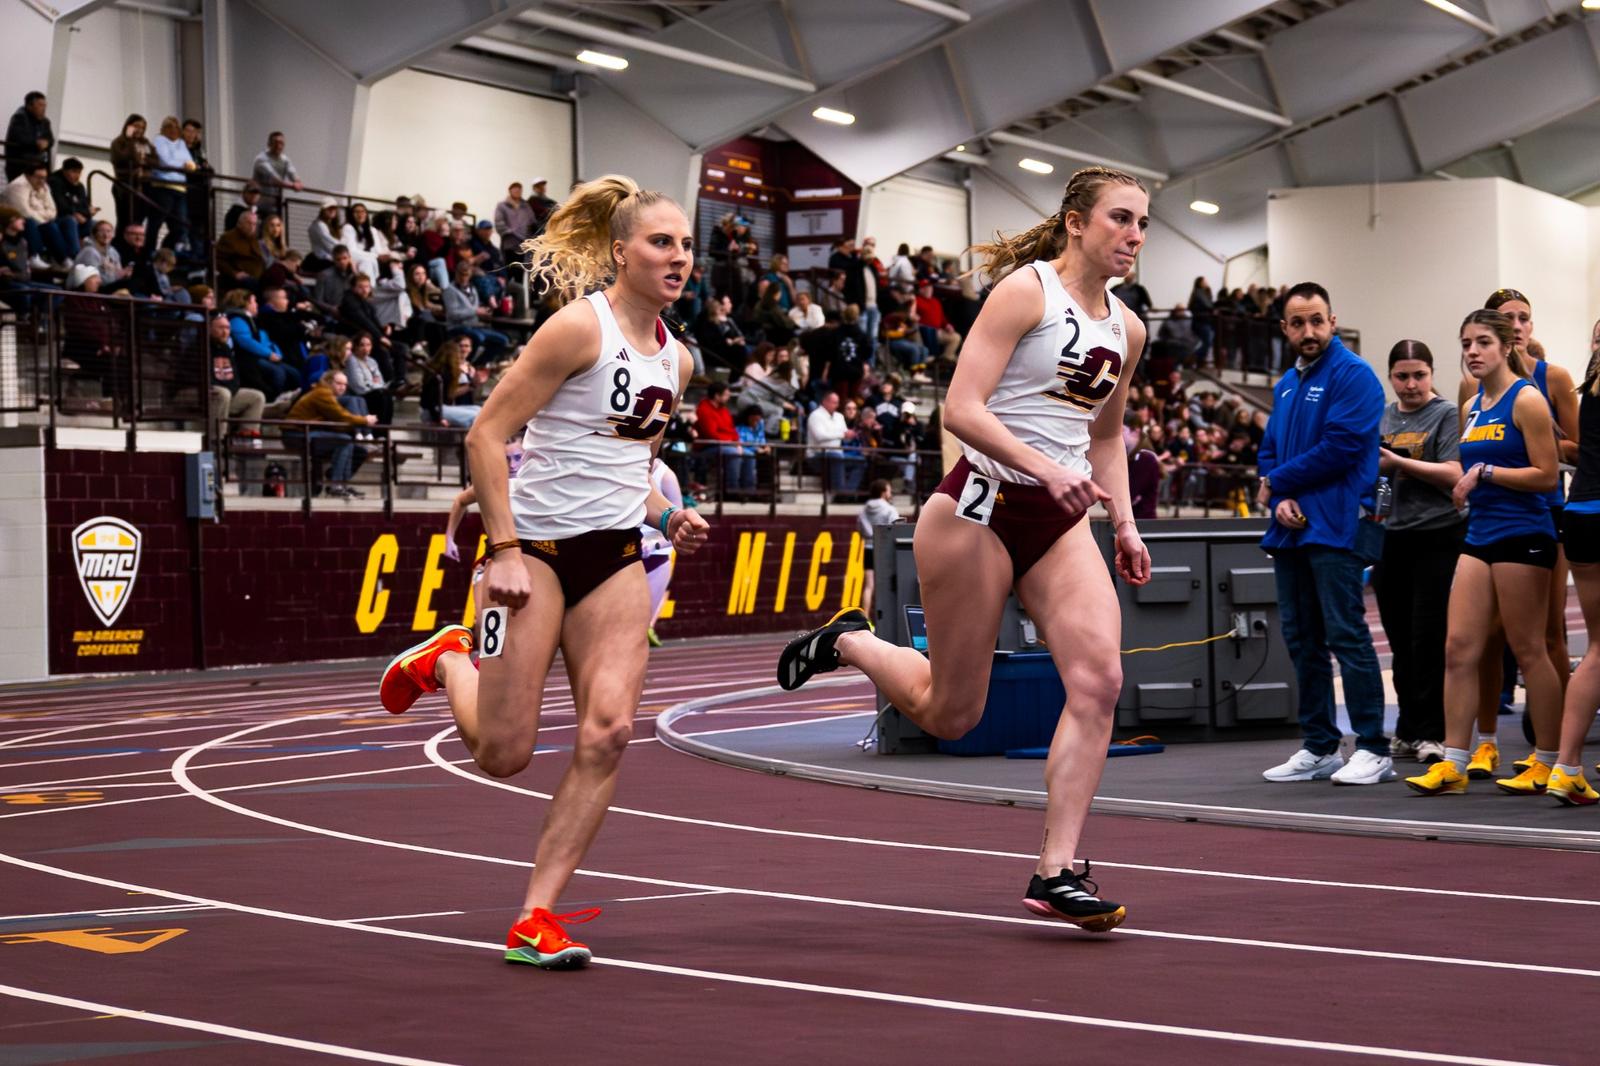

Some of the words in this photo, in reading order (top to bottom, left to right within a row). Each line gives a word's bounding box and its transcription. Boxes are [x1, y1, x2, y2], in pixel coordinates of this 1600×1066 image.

[1061, 317, 1080, 360] 2
[610, 367, 631, 412] 8
[962, 477, 990, 522] 2
[80, 552, 135, 578] MAC
[484, 610, 501, 655] 8
